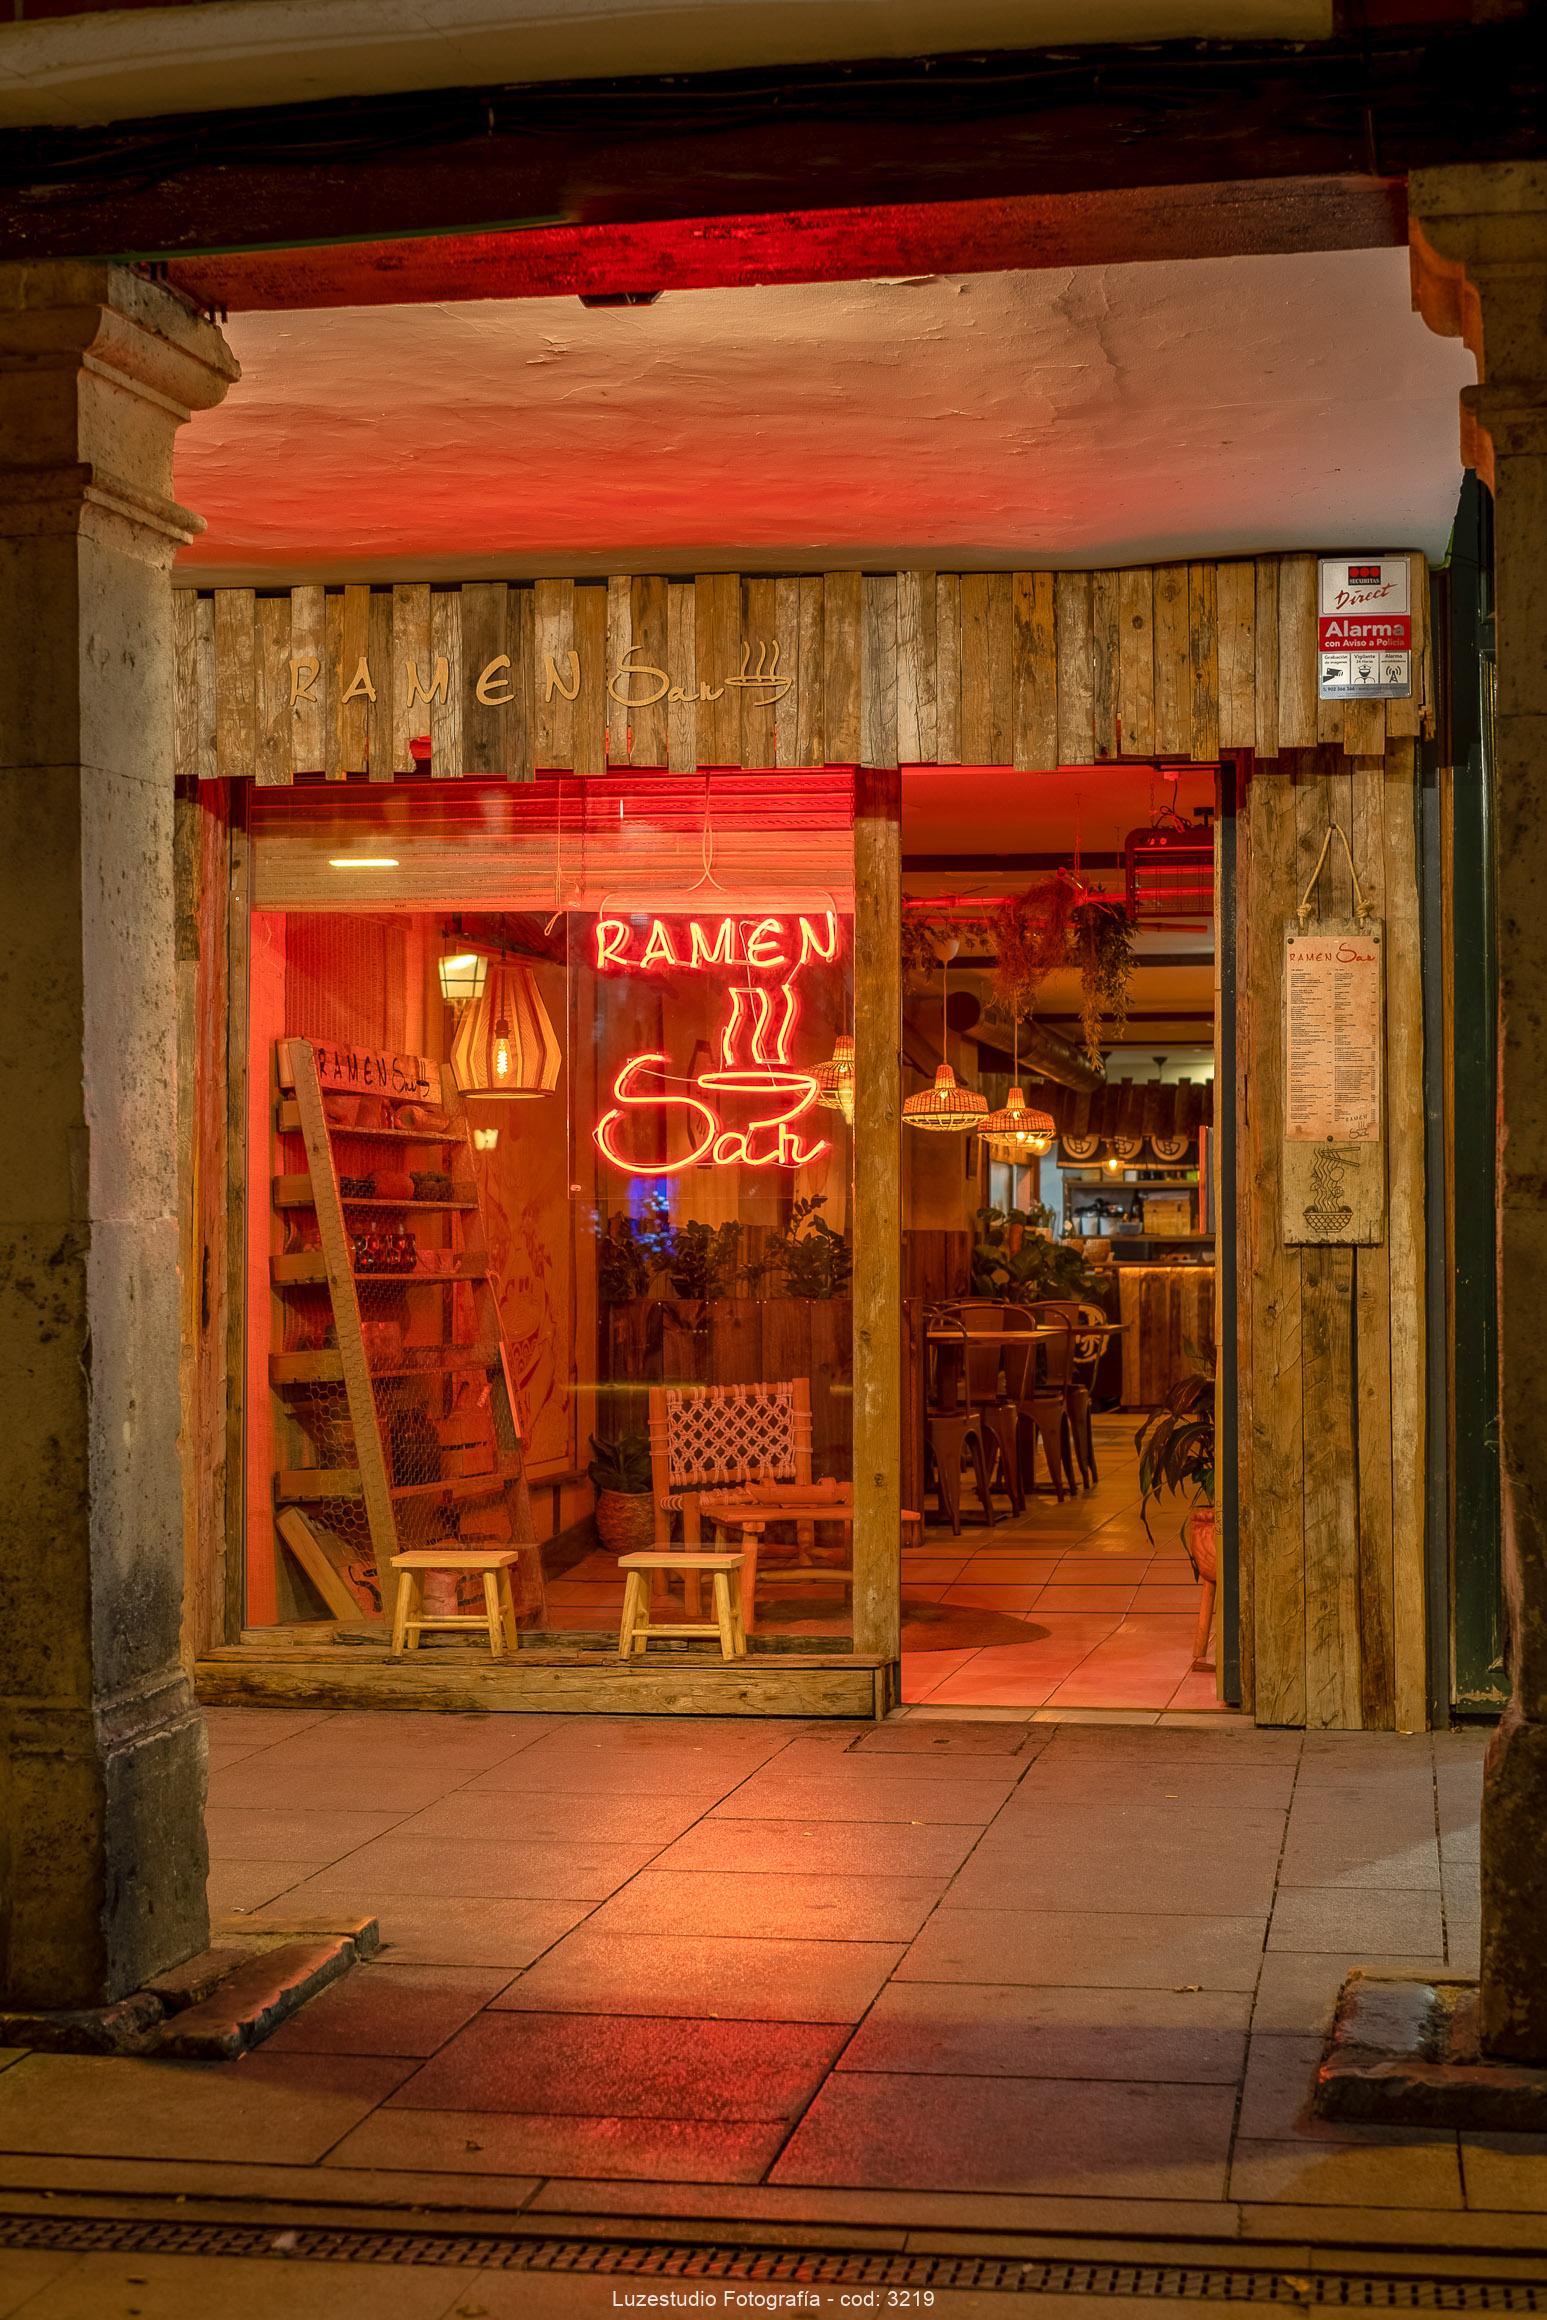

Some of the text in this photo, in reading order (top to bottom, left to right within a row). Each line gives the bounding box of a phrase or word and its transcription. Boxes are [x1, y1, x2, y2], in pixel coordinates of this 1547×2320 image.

[1335, 582, 1398, 609] Direct
[1325, 620, 1404, 638] Alarma
[1343, 639, 1367, 647] Aviso
[288, 645, 725, 708] RAMEN San
[597, 911, 836, 969] RAMEN
[1290, 943, 1376, 963] RAMEN San
[317, 1047, 387, 1087] RAMEN
[597, 1053, 828, 1173] San
